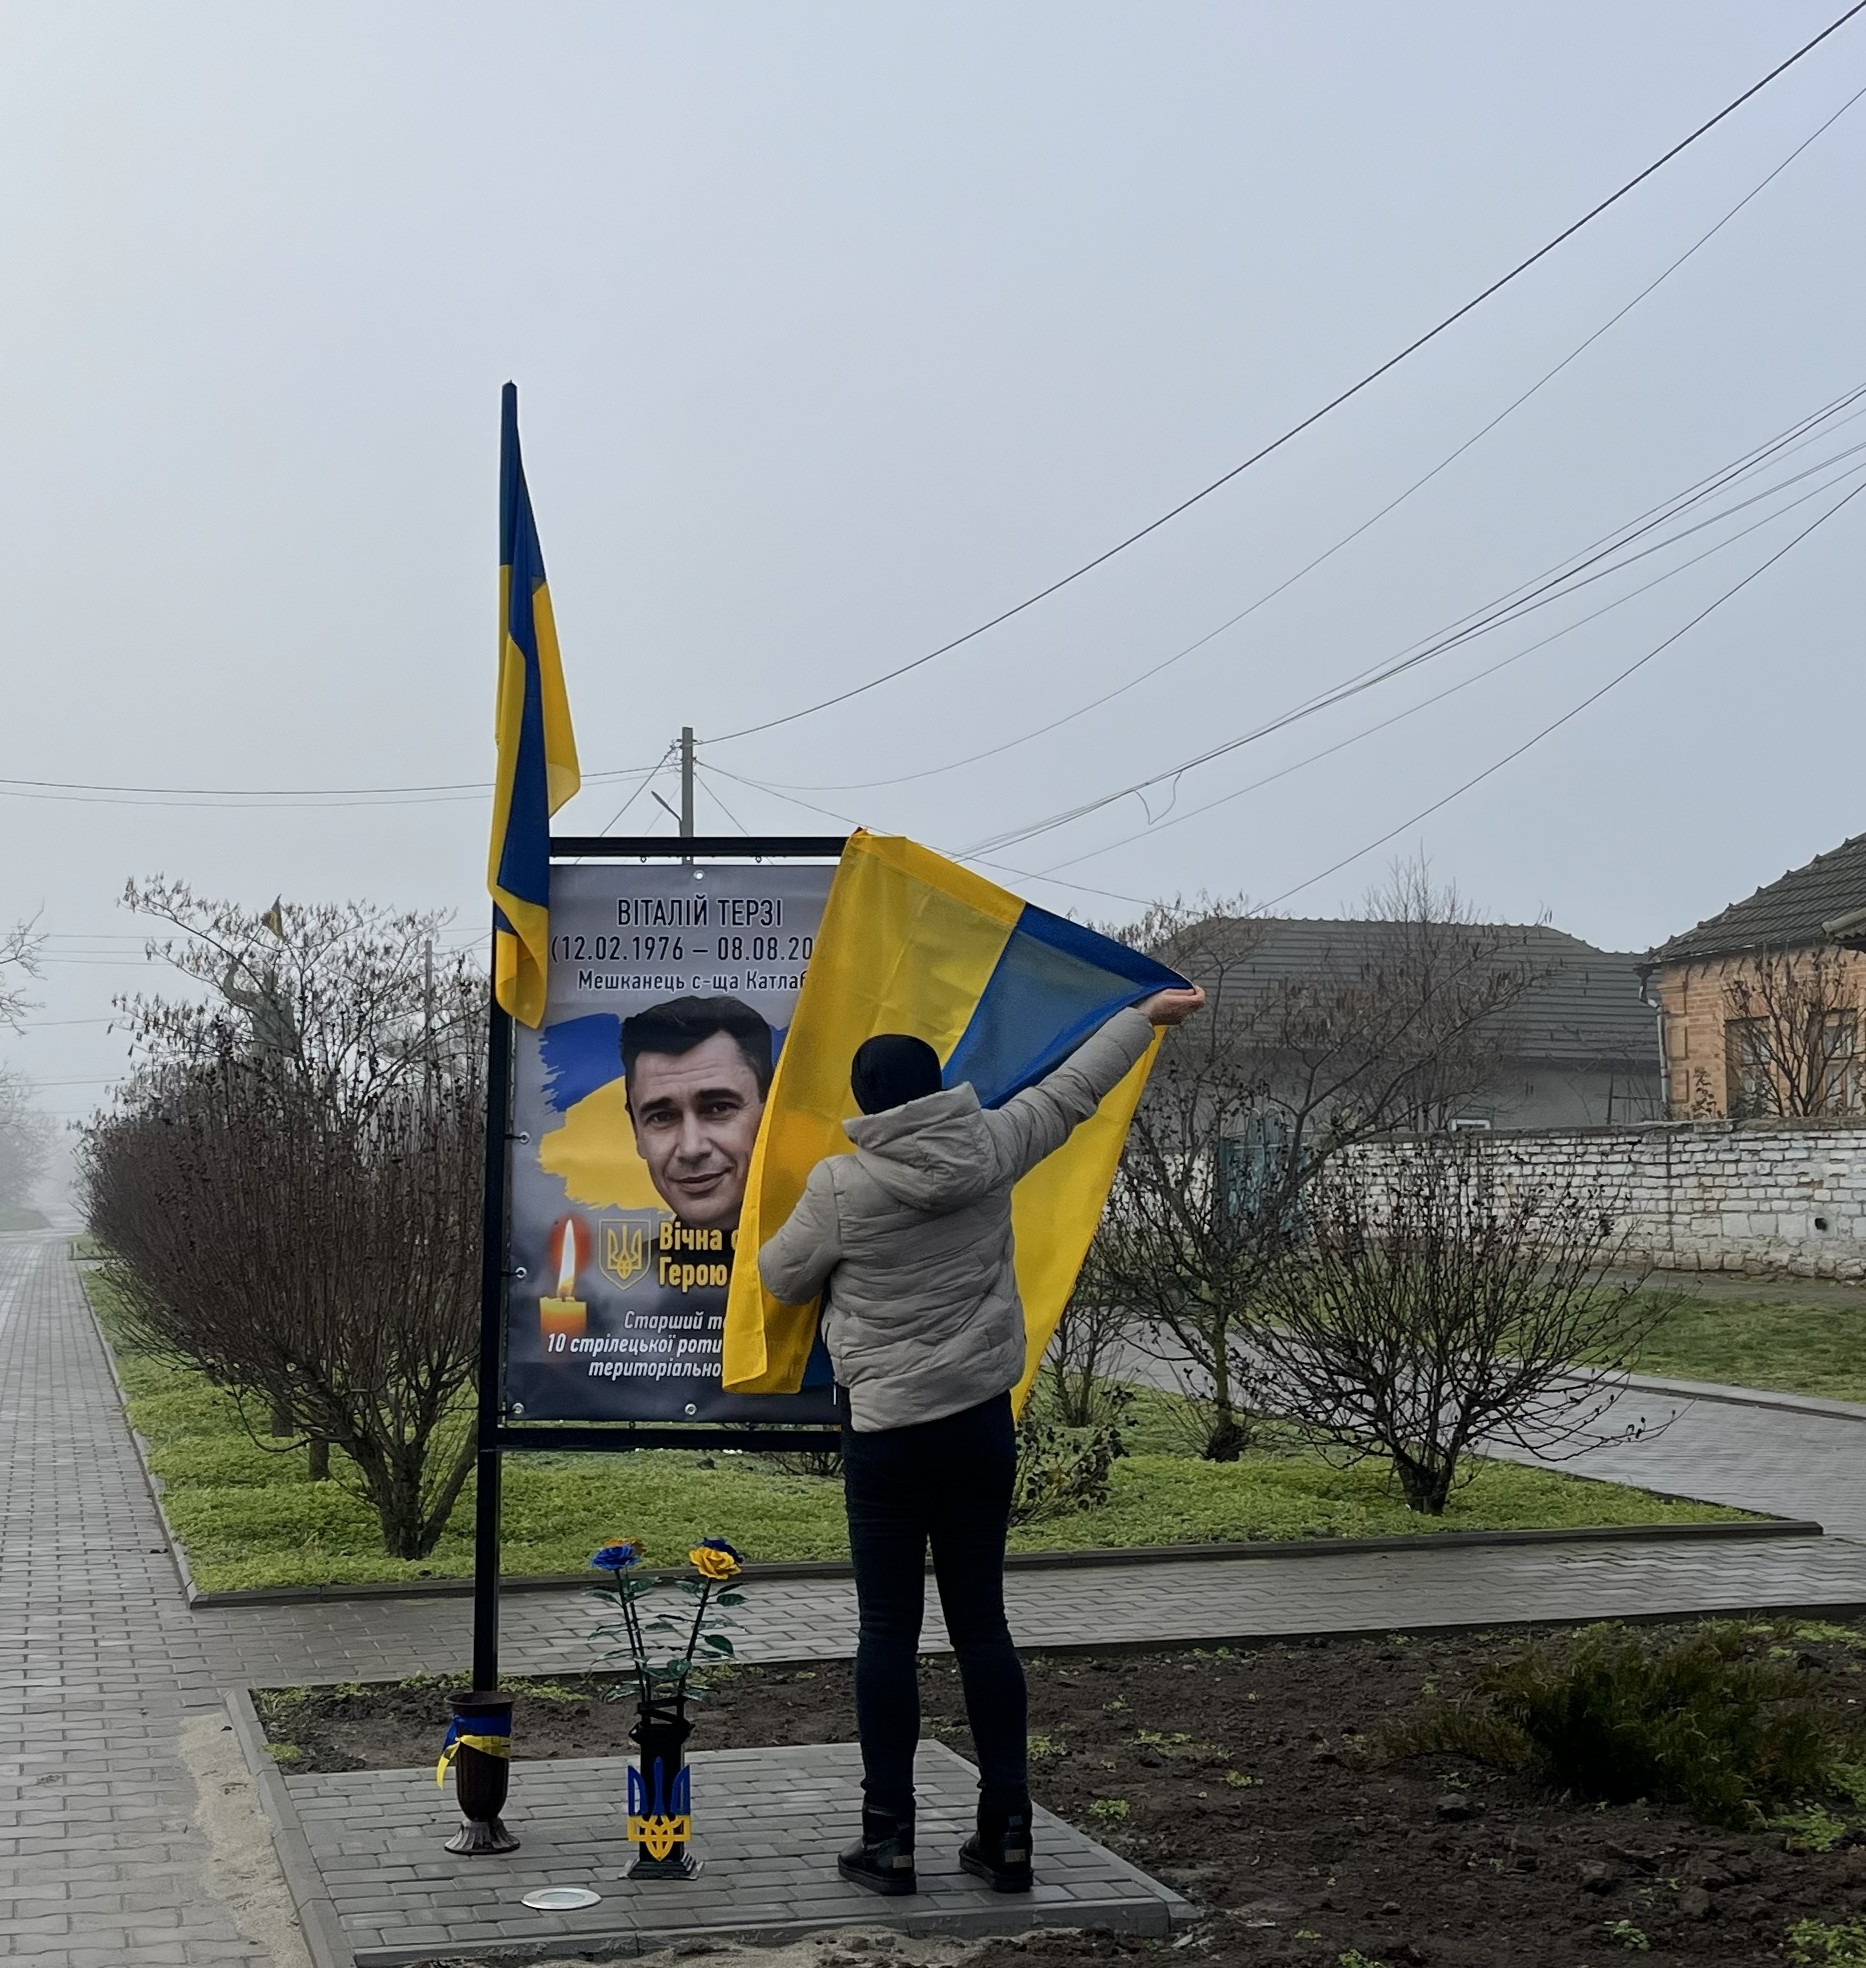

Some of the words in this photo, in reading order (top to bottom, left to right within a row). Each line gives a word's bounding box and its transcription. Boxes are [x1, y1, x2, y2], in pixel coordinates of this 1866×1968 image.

[617, 893, 708, 926] ВІТАЛІЙ
[717, 899, 782, 926] ТЕРЗІ
[551, 935, 684, 963] (12.02.1976
[578, 970, 685, 992] Мешканець
[692, 975, 739, 993] с-ща
[659, 1221, 723, 1251] Вічна
[659, 1256, 728, 1293] Герою
[624, 1310, 704, 1334] Старший
[547, 1332, 567, 1353] 10
[570, 1332, 677, 1358] стрілецької
[676, 1337, 723, 1358] роти
